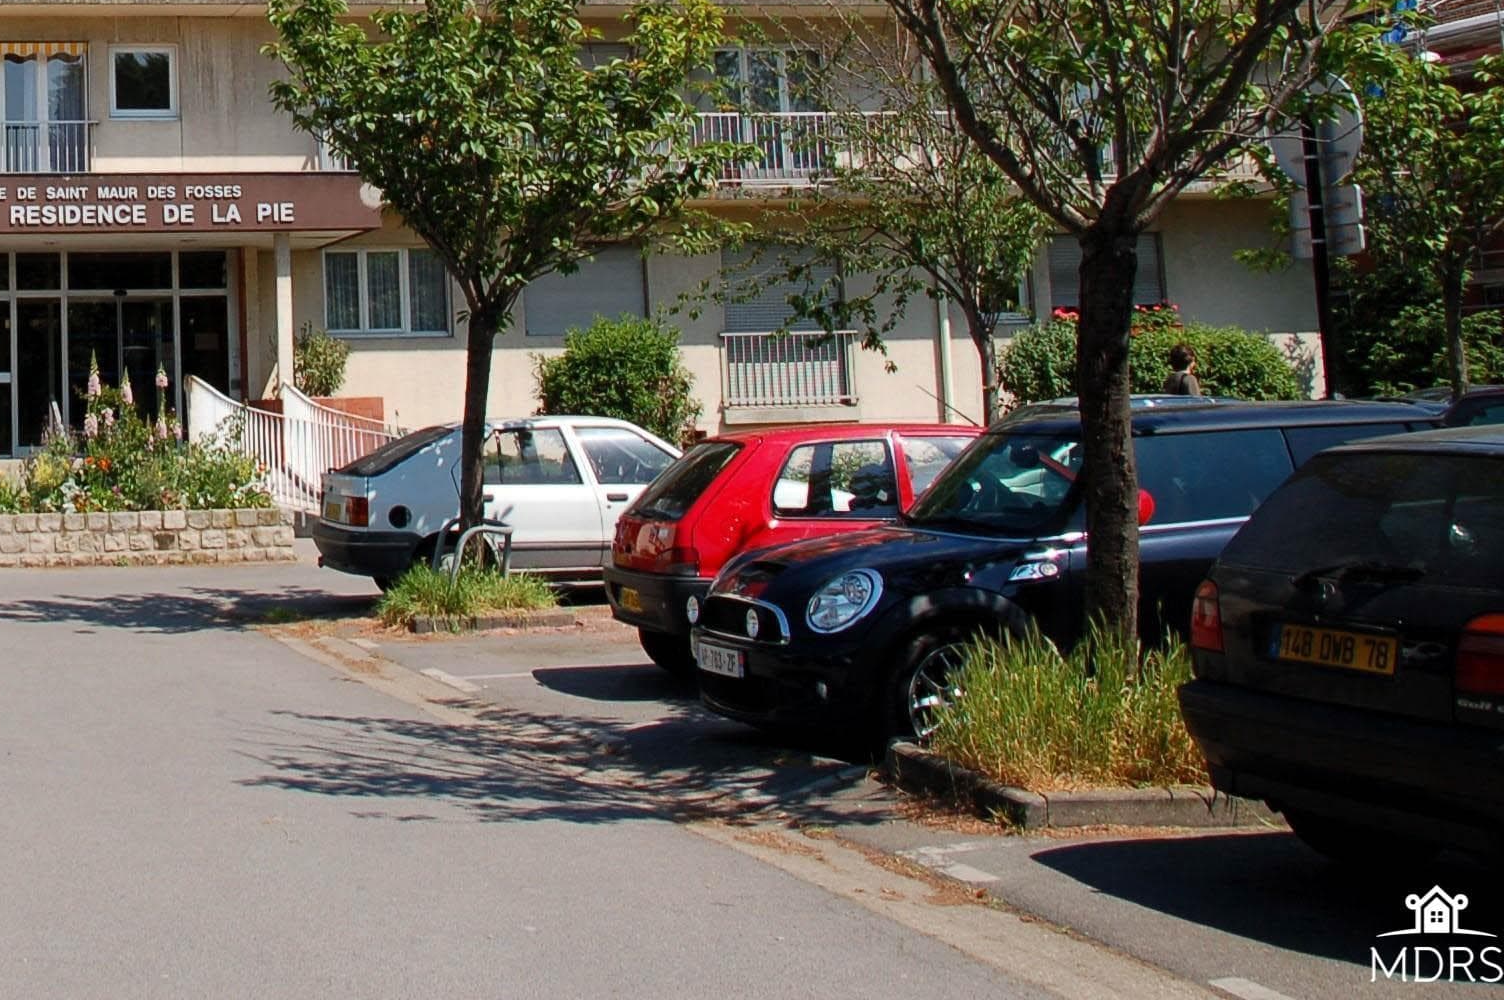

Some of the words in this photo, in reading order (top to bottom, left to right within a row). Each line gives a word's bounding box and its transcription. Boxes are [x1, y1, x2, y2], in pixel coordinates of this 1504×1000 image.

[17, 186, 37, 200] DE
[46, 186, 89, 200] SAINT
[97, 186, 138, 199] MAUR
[147, 185, 176, 199] DES
[185, 185, 242, 198] FOSSES
[9, 204, 147, 225] RESIDENCE
[163, 204, 195, 224] DE
[212, 203, 242, 223] LA
[256, 202, 295, 222] PIE
[1283, 627, 1313, 658] 148
[1364, 638, 1389, 669] 78
